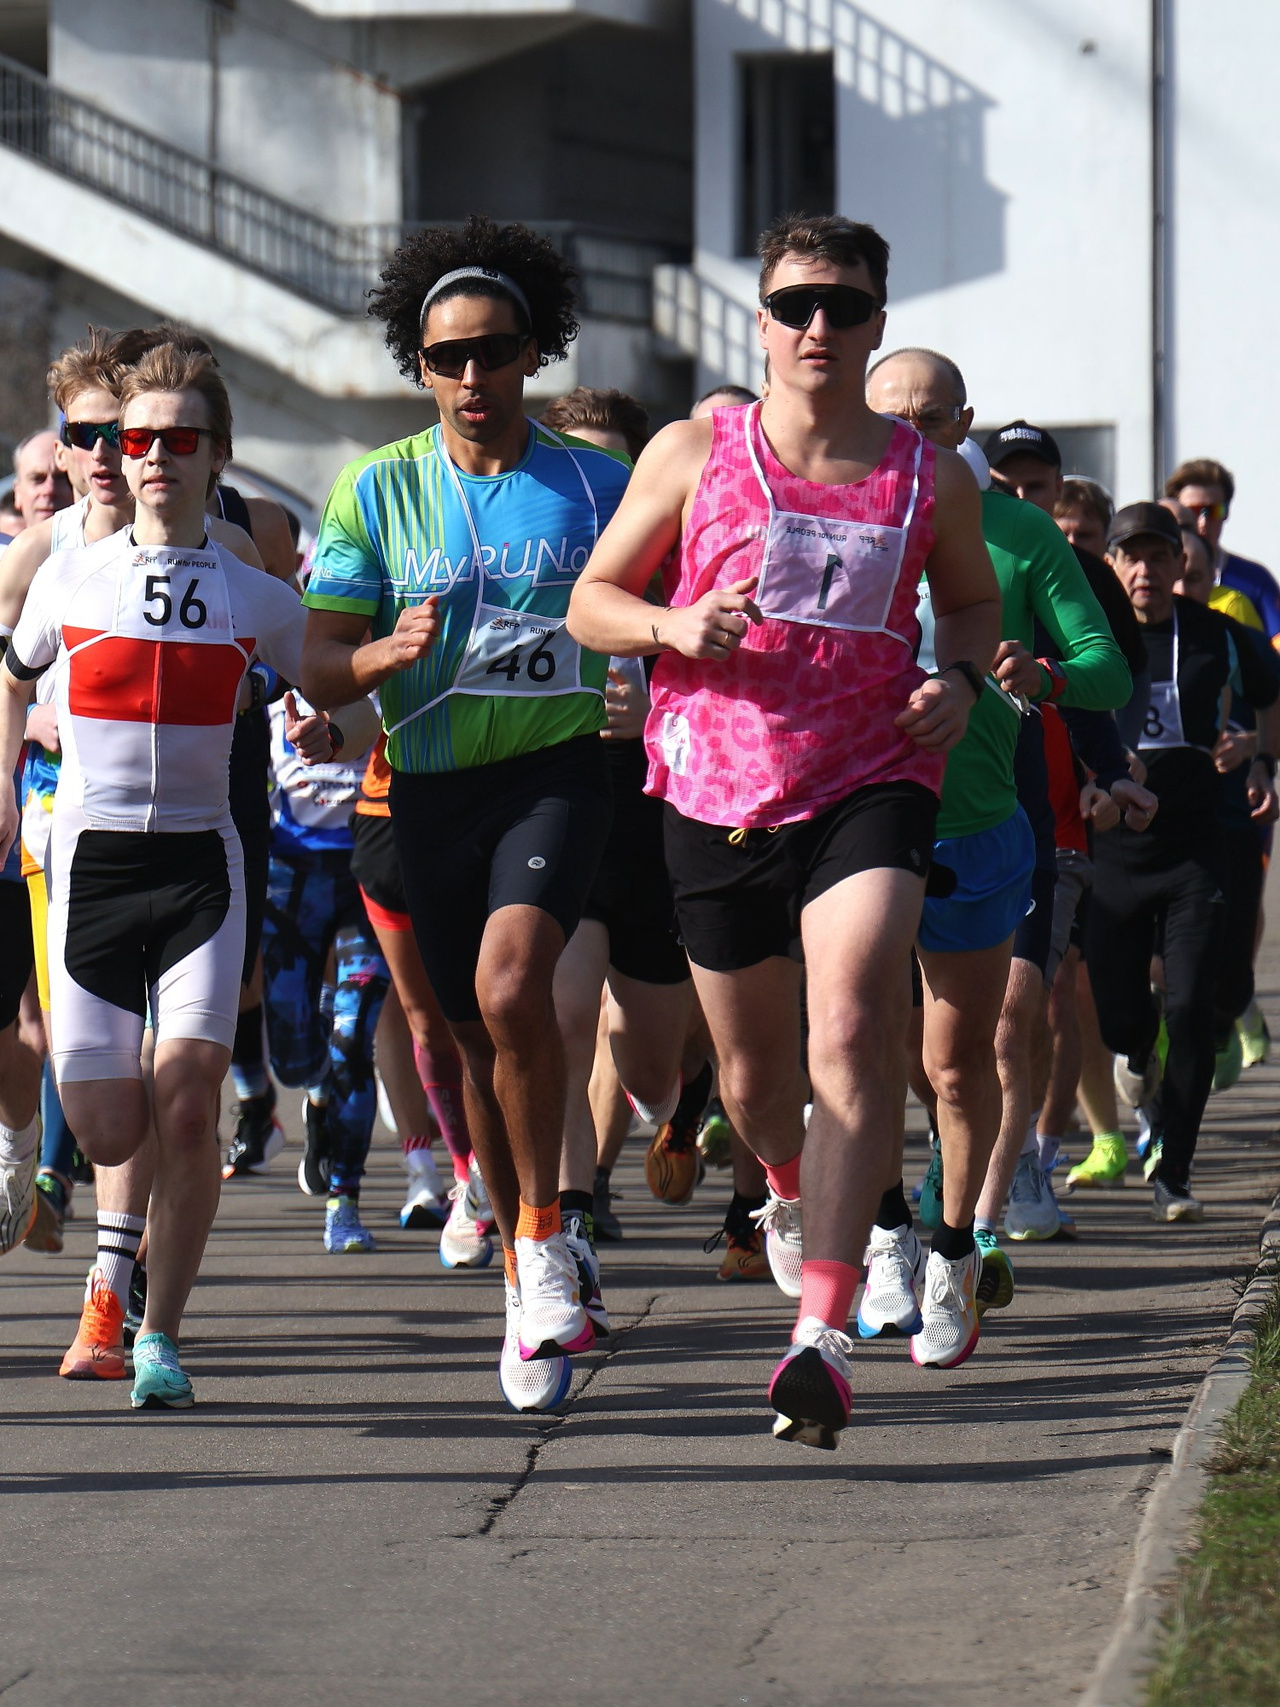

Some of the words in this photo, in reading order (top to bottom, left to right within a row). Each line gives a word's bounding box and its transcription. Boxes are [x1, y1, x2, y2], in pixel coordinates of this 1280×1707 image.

[167, 558, 183, 566] RUN
[183, 559, 191, 567] for
[191, 560, 217, 570] PEOPLE
[143, 575, 207, 629] 56
[504, 620, 520, 631] RFP
[530, 626, 546, 635] RUN
[486, 631, 556, 682] 46
